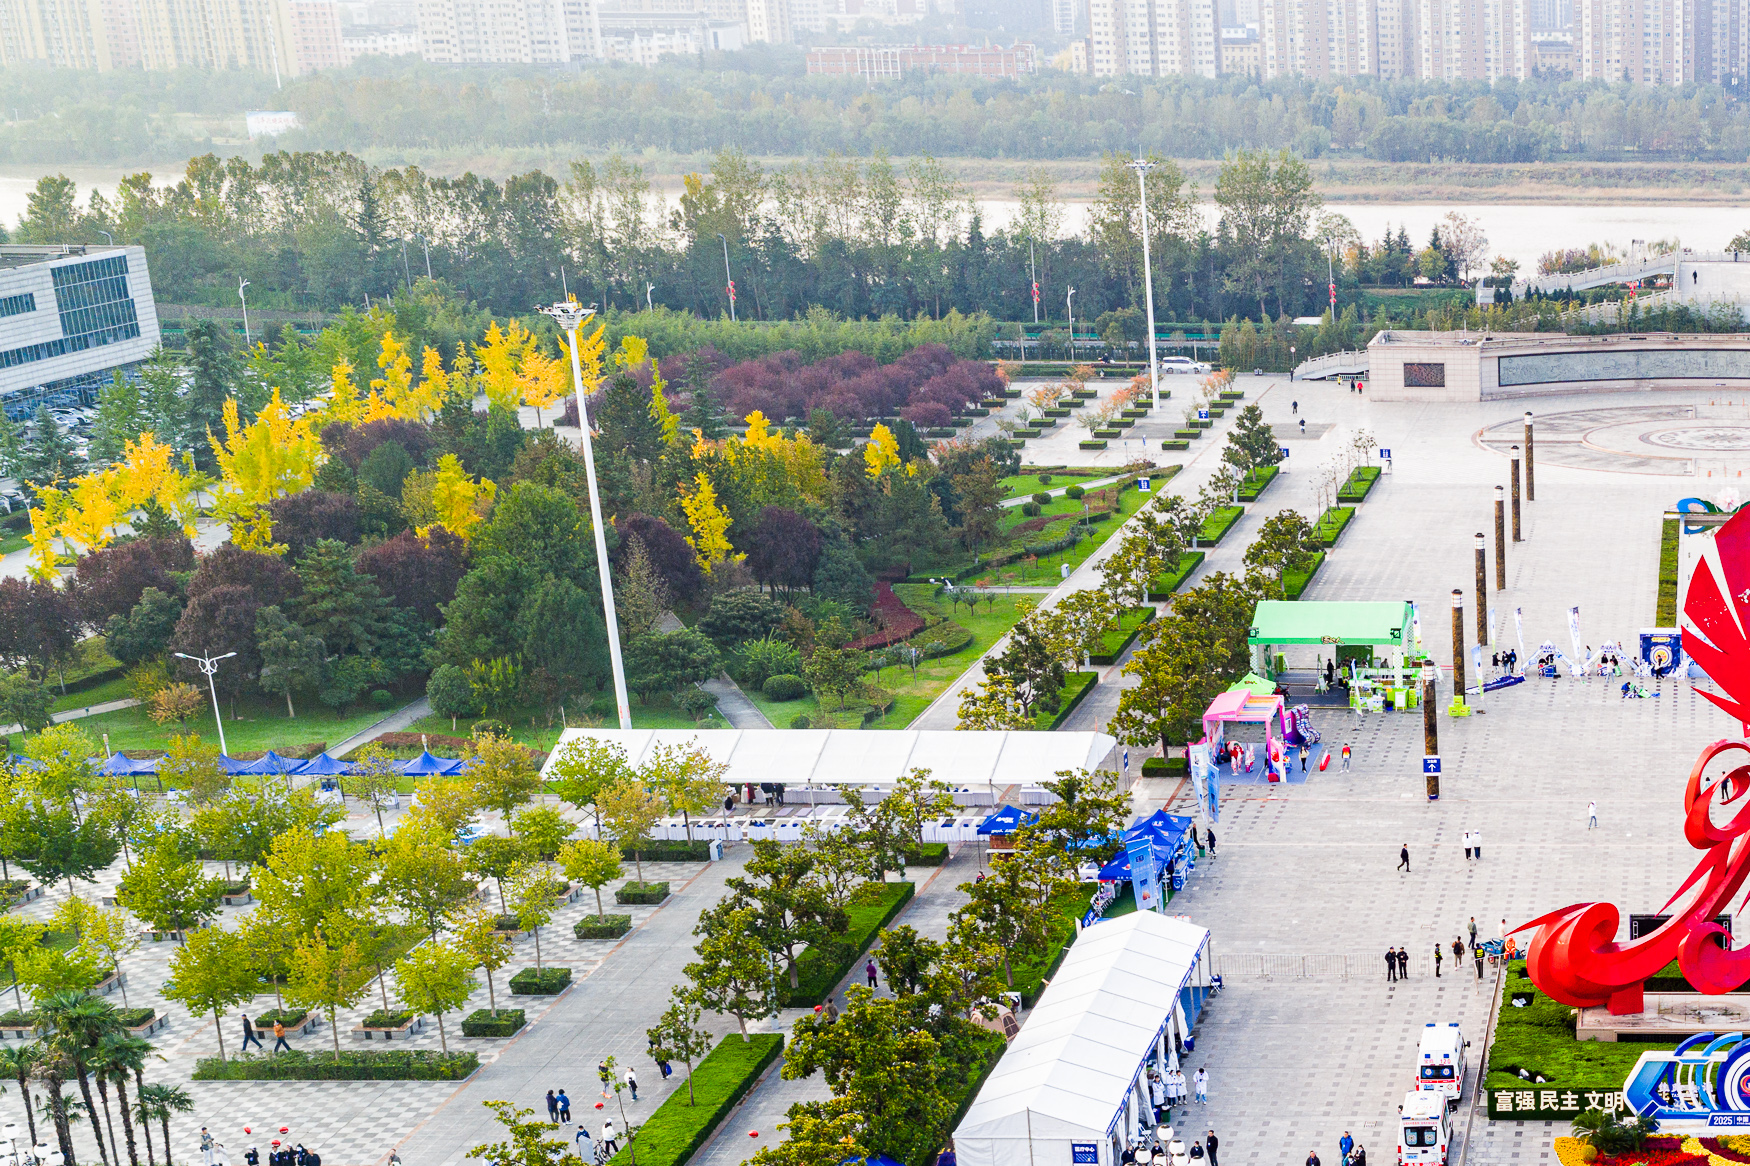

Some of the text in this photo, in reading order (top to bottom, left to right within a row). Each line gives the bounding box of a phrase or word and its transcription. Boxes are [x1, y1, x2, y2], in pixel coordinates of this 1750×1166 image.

[1495, 1091, 1625, 1111] 富强 民主 文明
[1713, 1116, 1733, 1125] 2025
